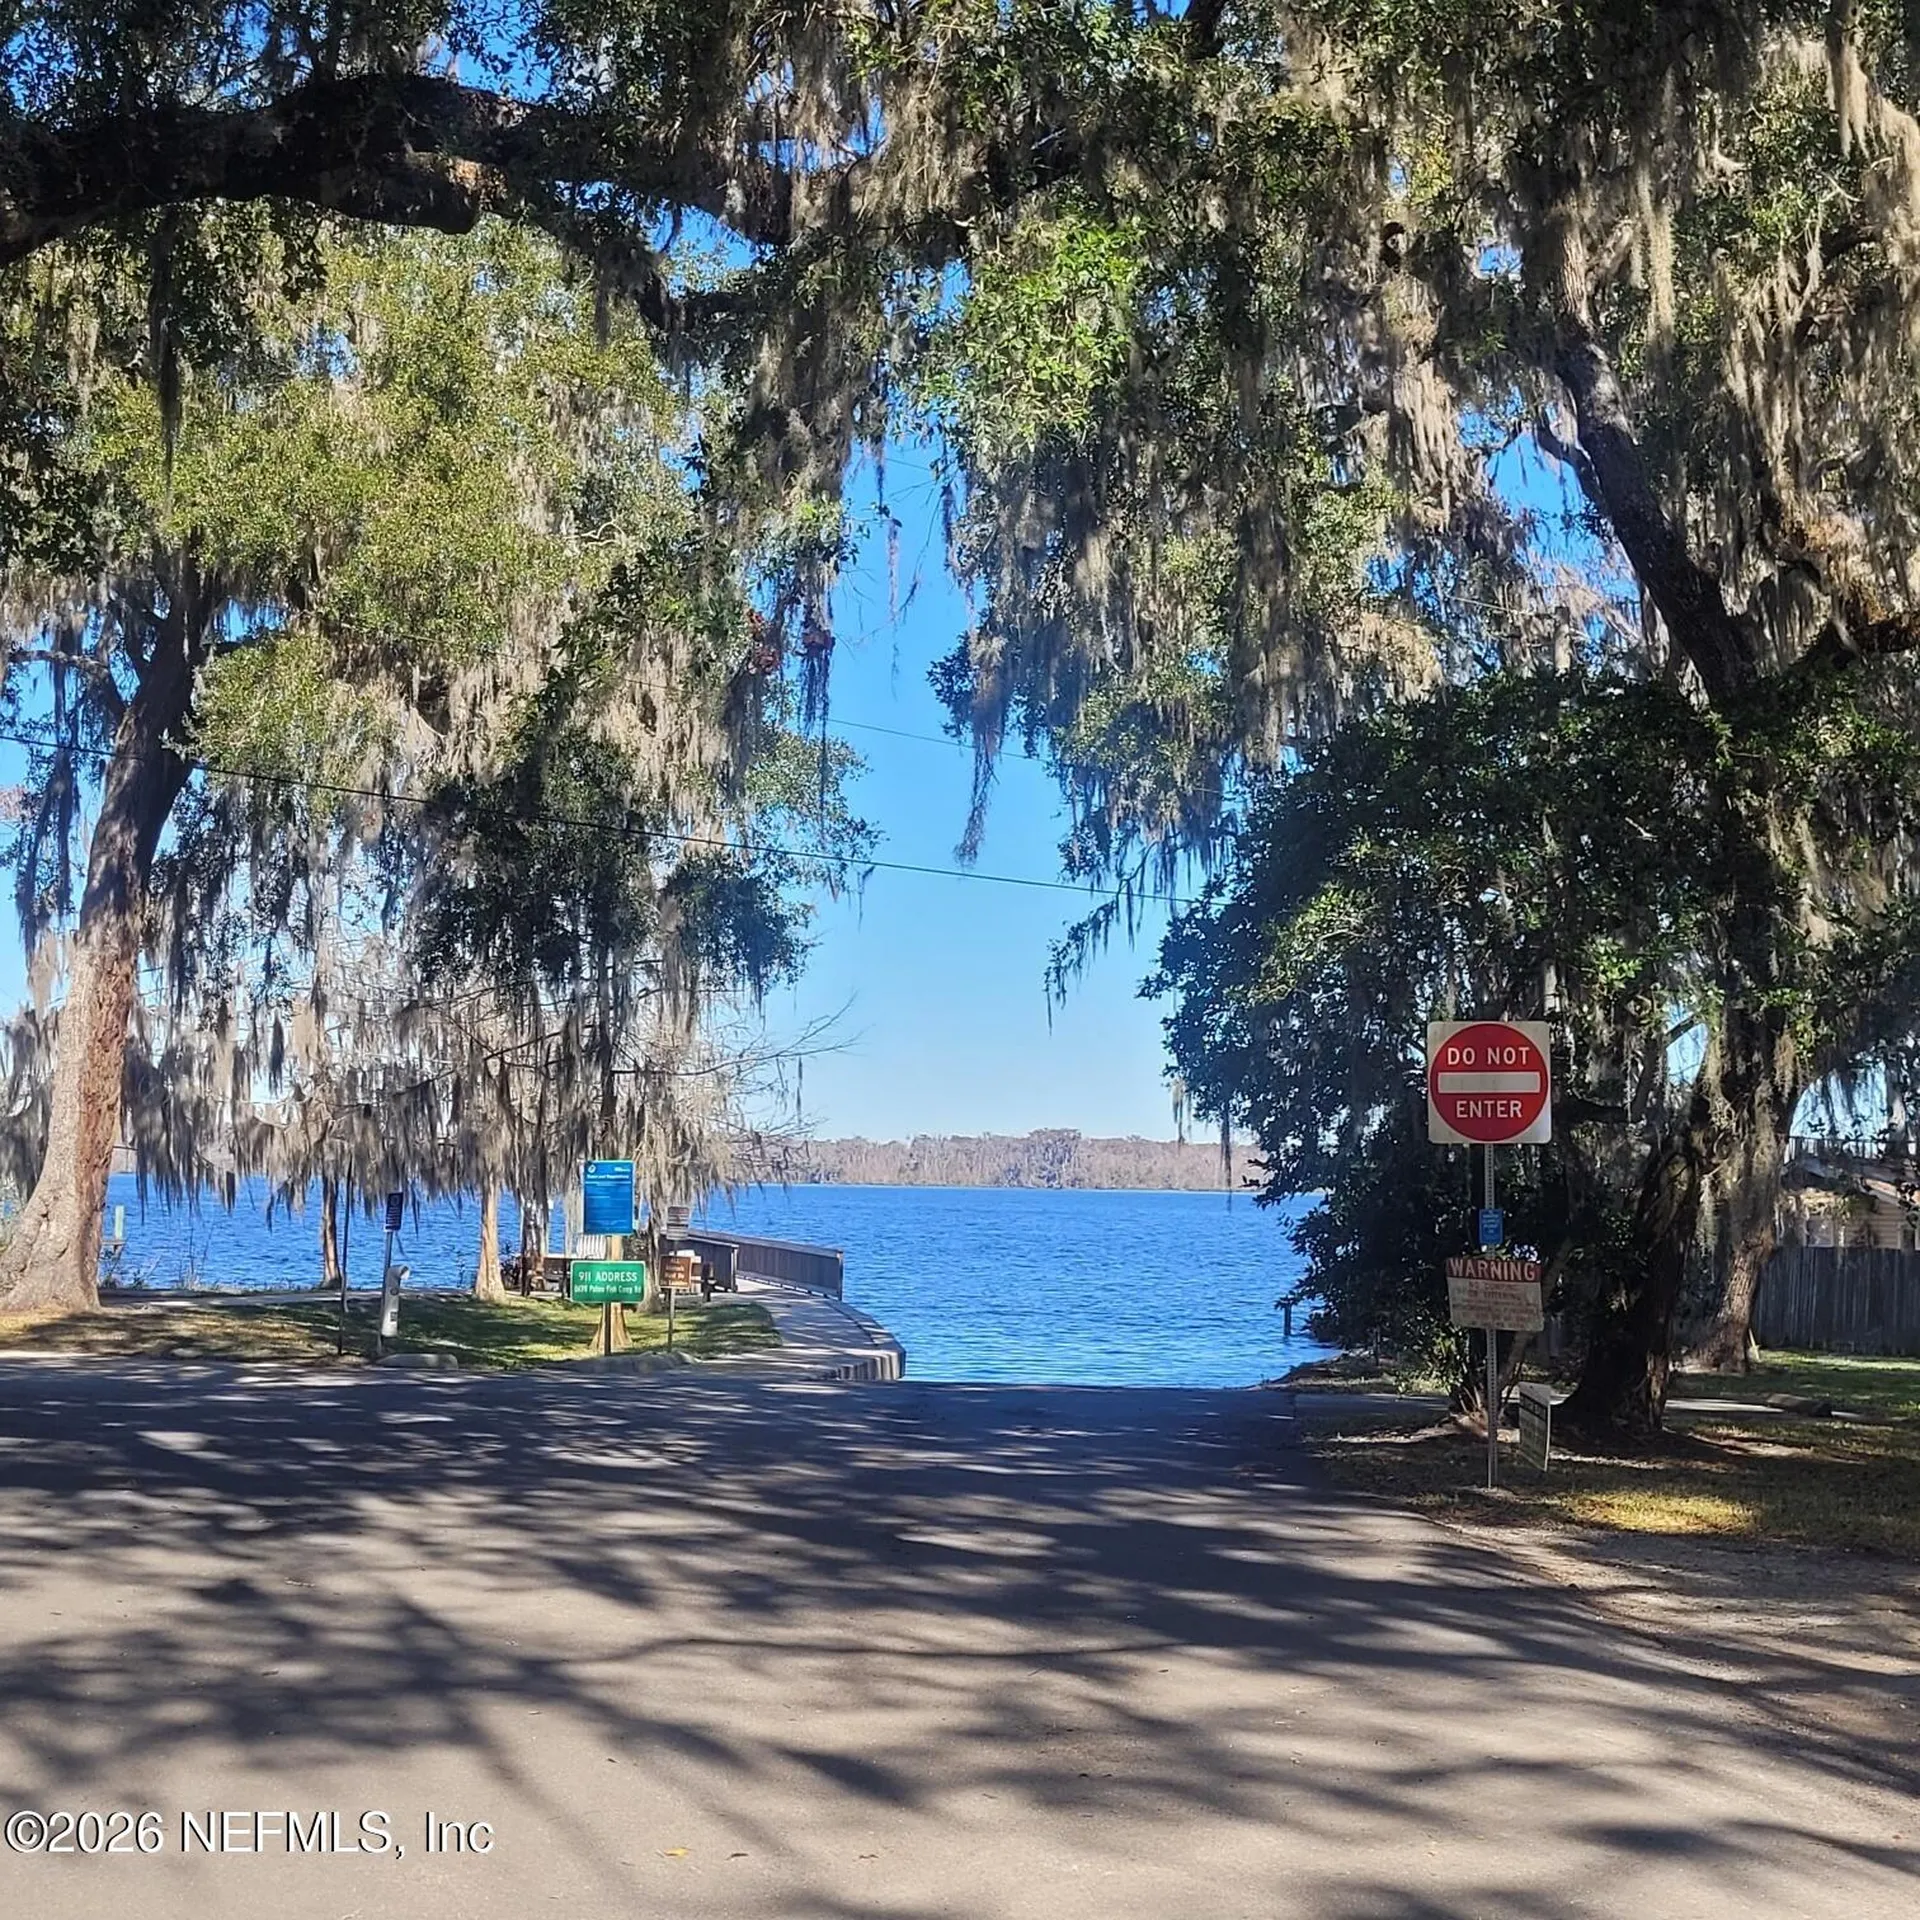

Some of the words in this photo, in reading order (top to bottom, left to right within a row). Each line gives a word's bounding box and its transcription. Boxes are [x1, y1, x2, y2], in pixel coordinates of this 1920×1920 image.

[1447, 1046, 1476, 1066] DO
[1487, 1046, 1531, 1066] NOT
[1456, 1100, 1523, 1118] ENTER
[578, 1271, 592, 1282] 911
[595, 1271, 638, 1282] ADDRESS
[1449, 1258, 1536, 1281] WARNING
